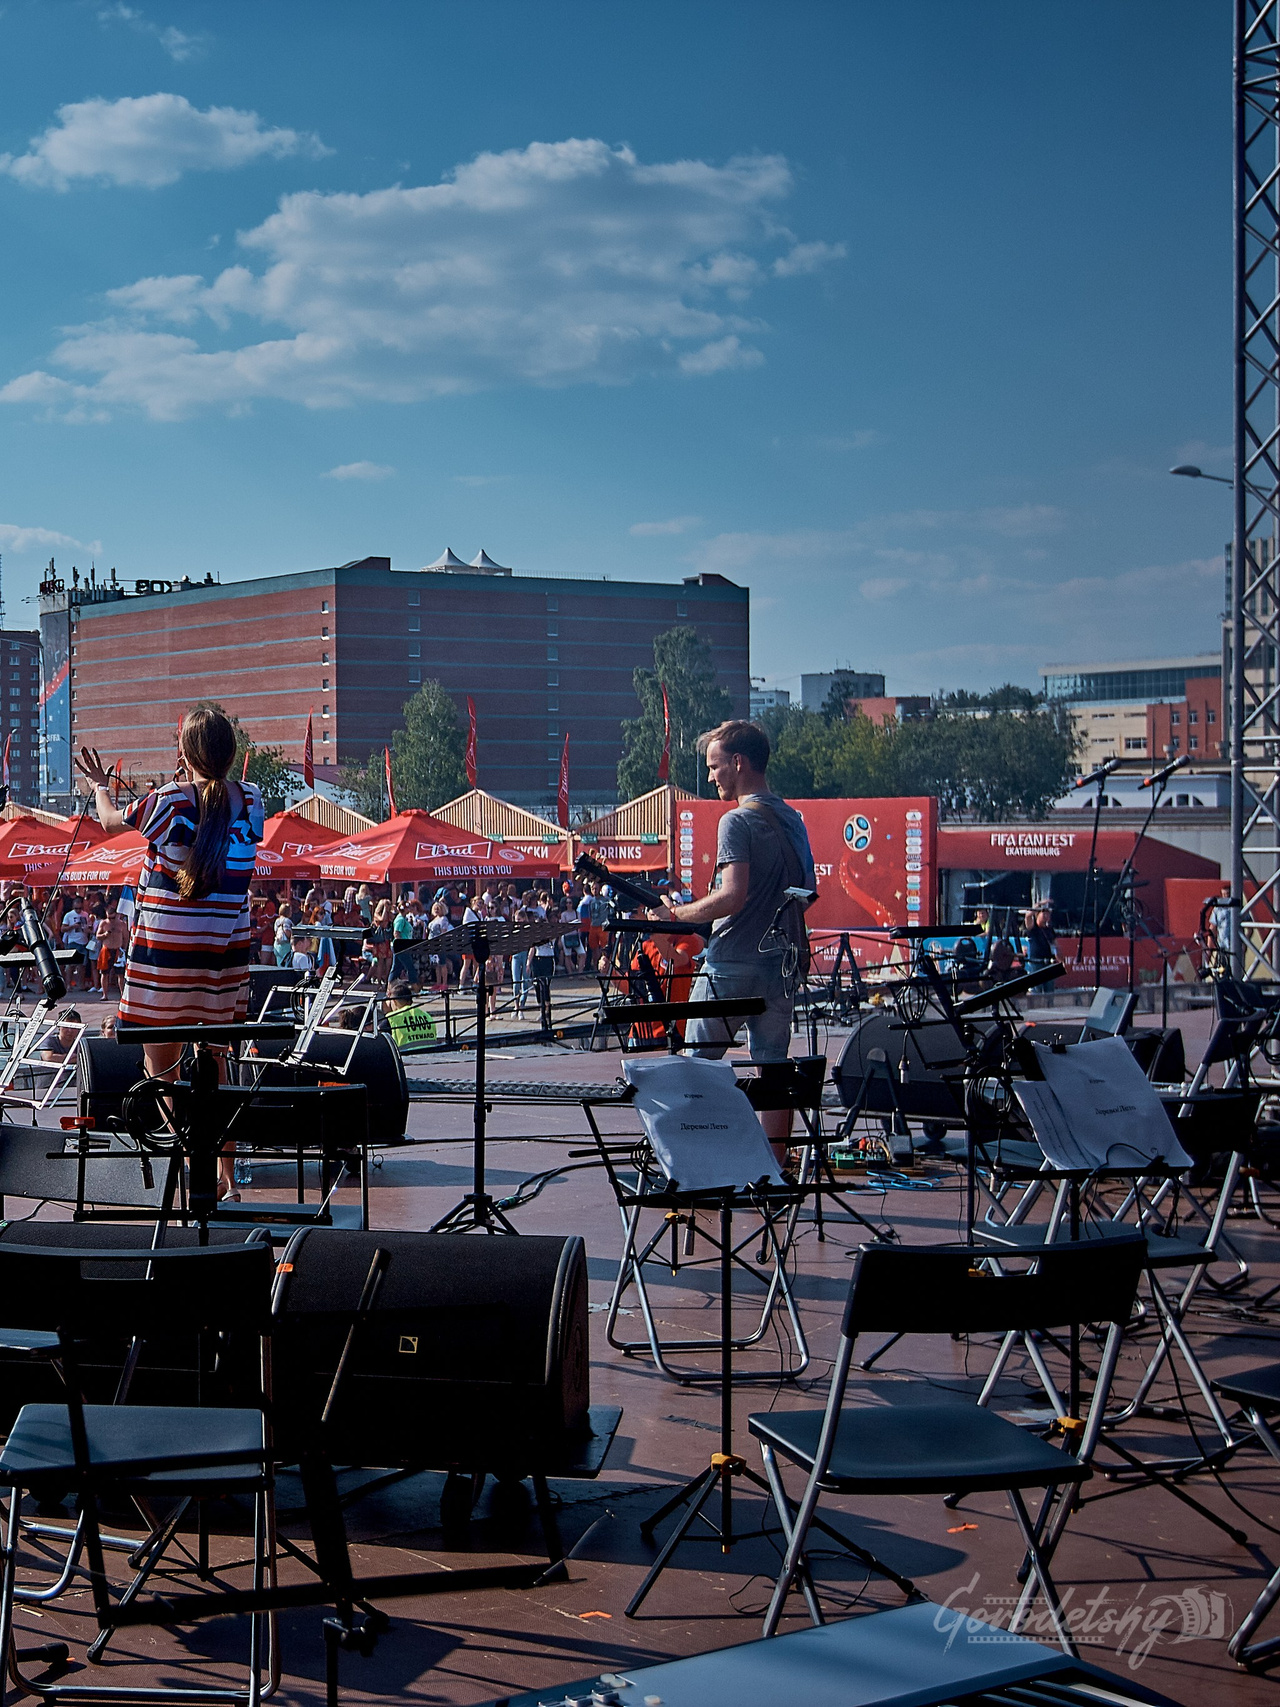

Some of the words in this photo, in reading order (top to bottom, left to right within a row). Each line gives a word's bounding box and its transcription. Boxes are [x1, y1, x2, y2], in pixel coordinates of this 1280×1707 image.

[990, 833, 1016, 847] FIFA
[1018, 833, 1043, 847] FAN
[1045, 833, 1076, 847] FEST
[16, 844, 71, 856] Bud
[421, 843, 476, 857] Bud
[600, 846, 642, 859] DRINKS
[1005, 847, 1060, 857] EKATERINBURG
[24, 862, 43, 873] THIS
[254, 866, 272, 875] YOU
[333, 865, 344, 876] FOR
[344, 866, 357, 876] YOU
[433, 866, 452, 876] THIS
[453, 865, 477, 876] BUD'S
[478, 865, 494, 875] FOR
[495, 864, 513, 875] YOU
[814, 864, 833, 876] EST
[70, 871, 87, 881] BUD'S
[87, 870, 98, 880] FOR
[98, 870, 111, 880] YOU
[407, 1033, 435, 1042] STEWARD
[680, 1122, 729, 1131] Дерево/Лето
